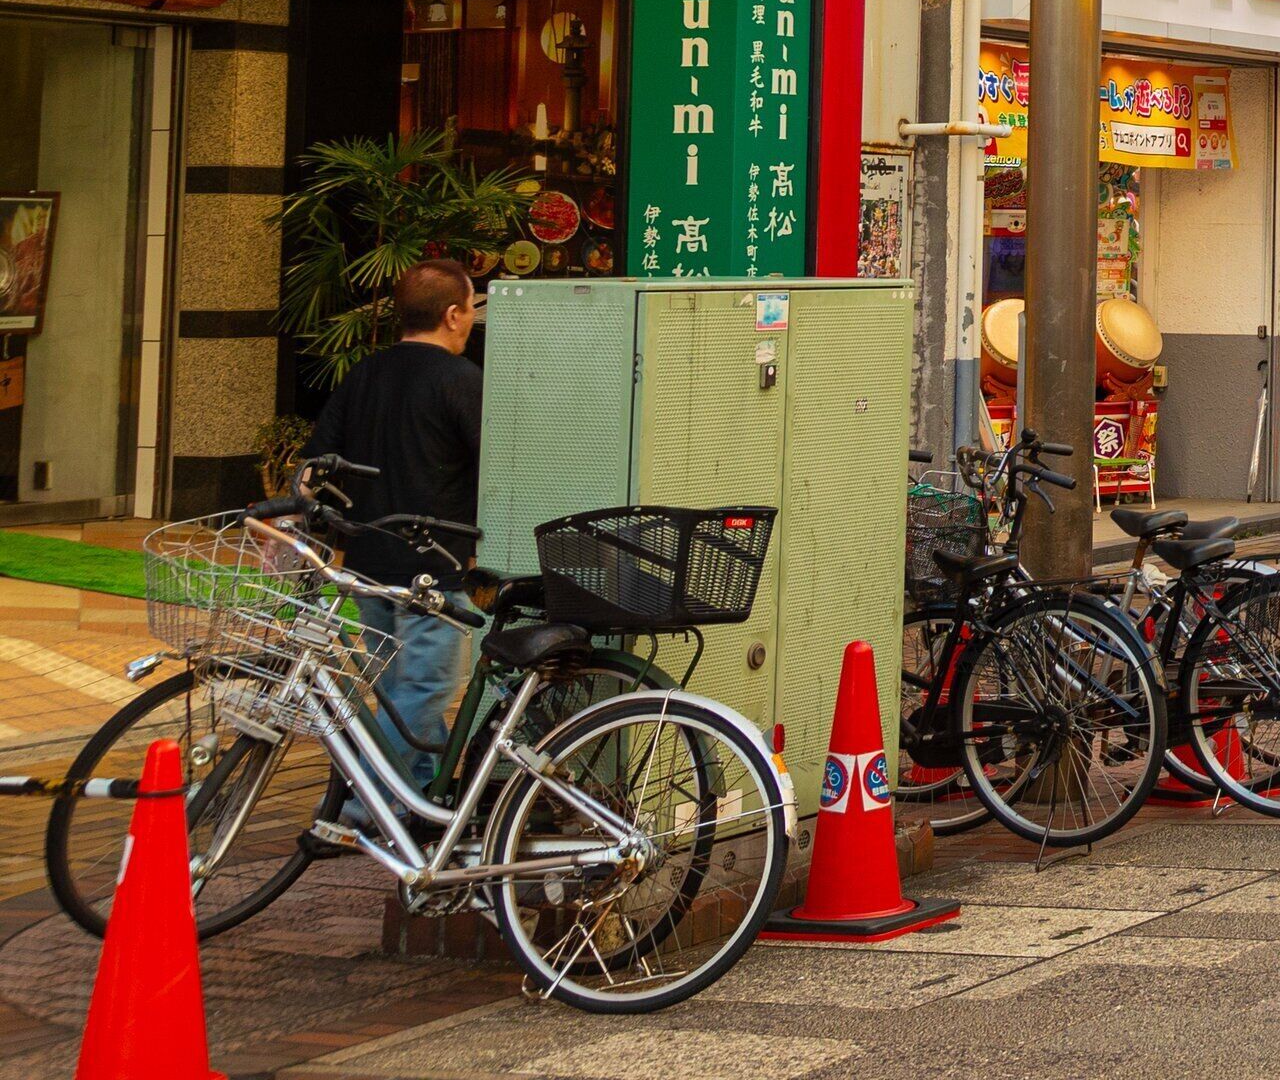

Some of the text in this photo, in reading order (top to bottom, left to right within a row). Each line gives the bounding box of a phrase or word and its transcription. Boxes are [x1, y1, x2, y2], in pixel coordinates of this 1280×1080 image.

[748, 40, 766, 138] 黒毛和牛
[1096, 426, 1120, 455] 祭
